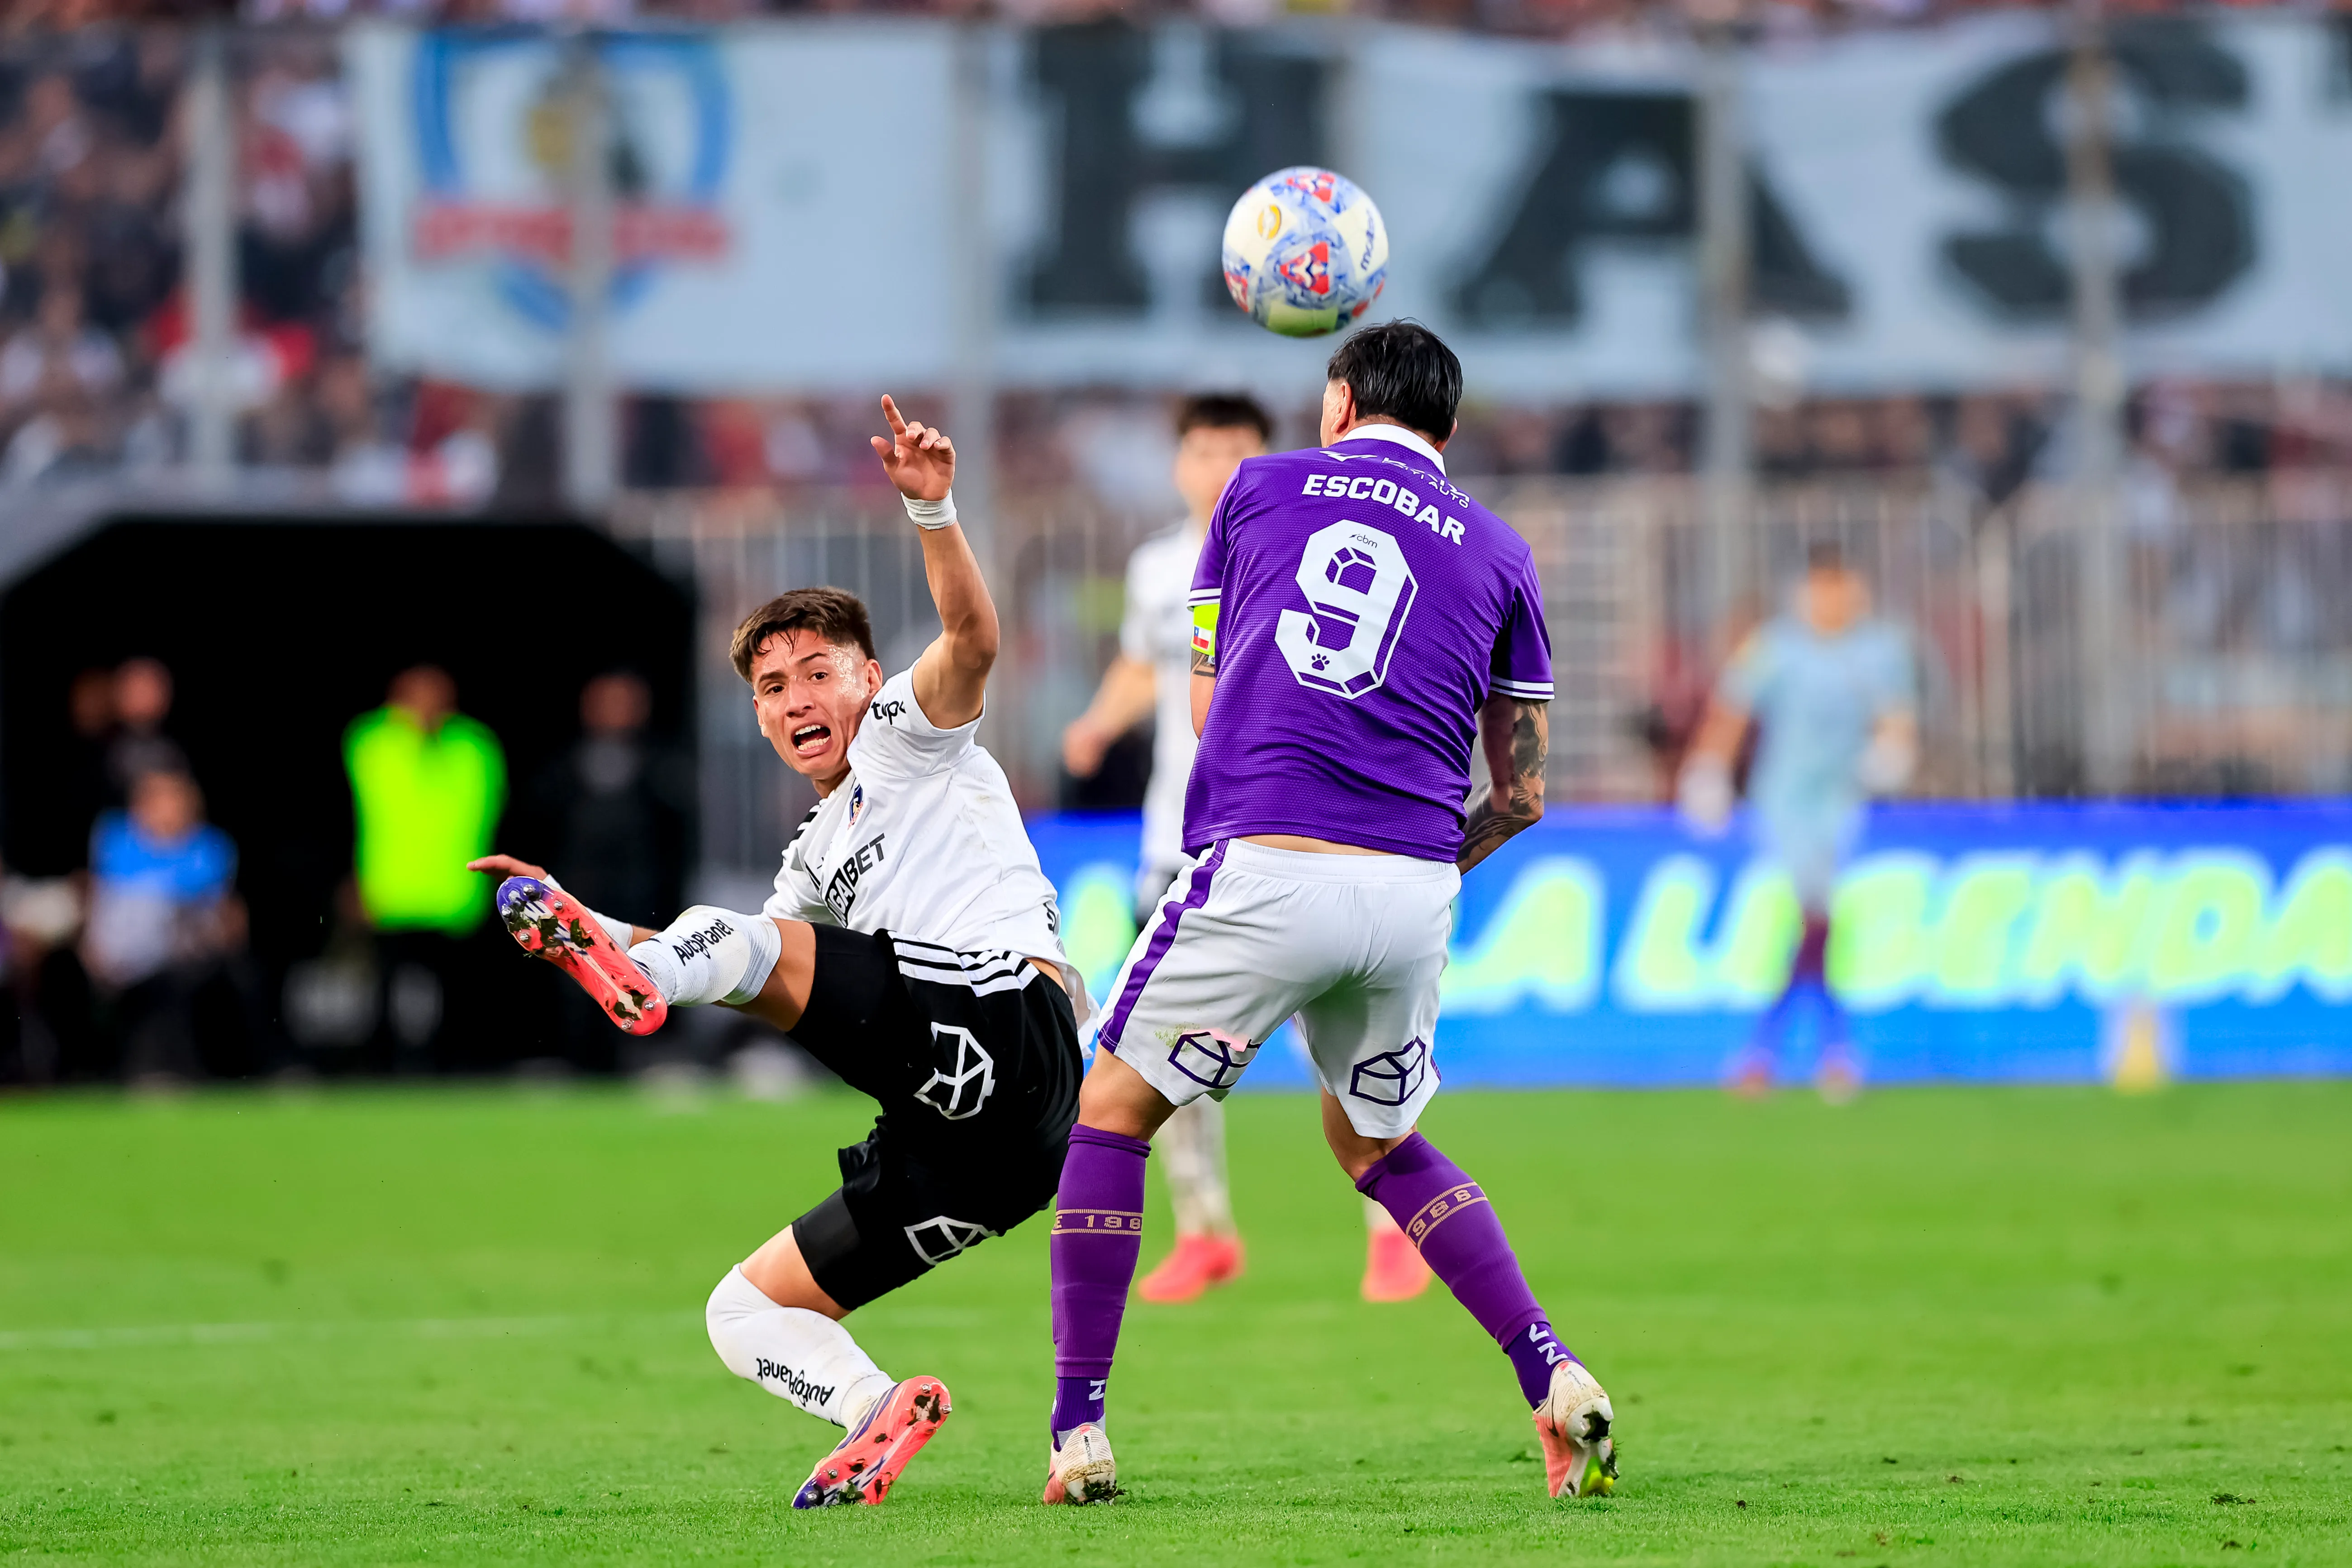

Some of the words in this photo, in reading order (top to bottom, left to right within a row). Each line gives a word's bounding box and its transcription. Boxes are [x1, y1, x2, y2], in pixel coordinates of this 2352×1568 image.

[1302, 474, 1466, 546] ESCOBAR
[1357, 534, 1378, 548] cbm
[1274, 519, 1419, 700] 9
[671, 918, 735, 967] AutoPlanet
[756, 1358, 836, 1408] AutoPlanet
